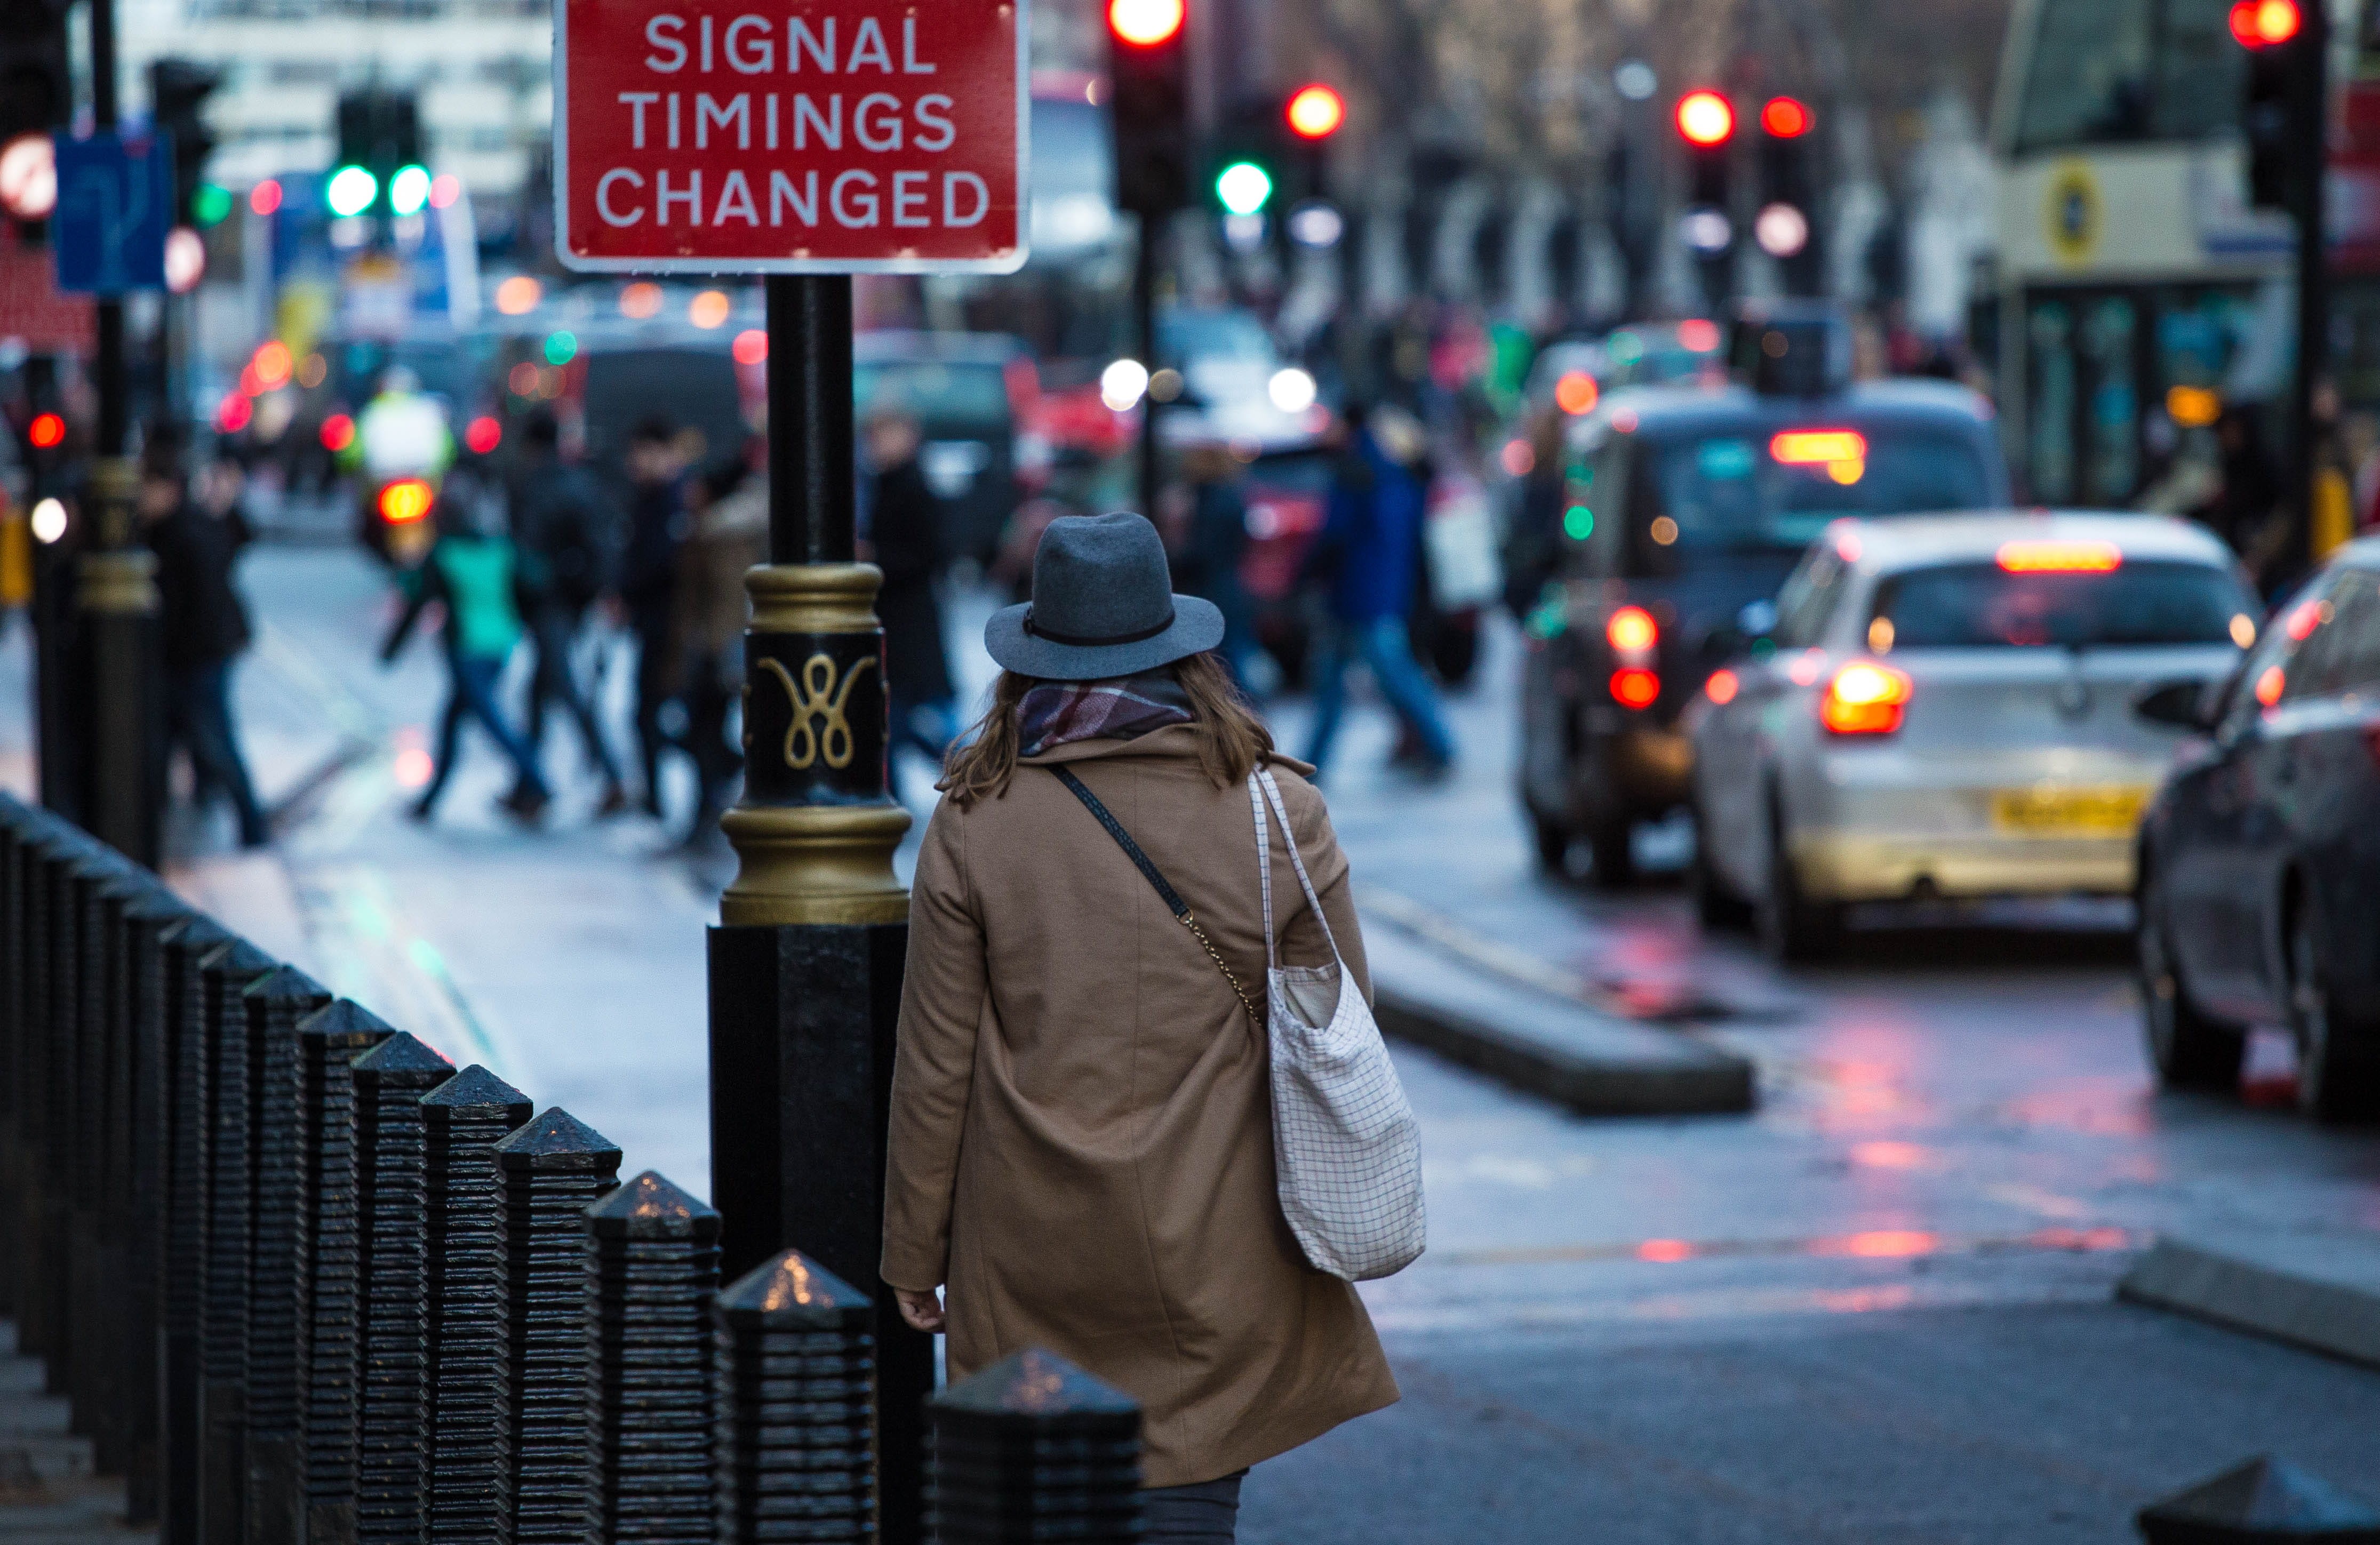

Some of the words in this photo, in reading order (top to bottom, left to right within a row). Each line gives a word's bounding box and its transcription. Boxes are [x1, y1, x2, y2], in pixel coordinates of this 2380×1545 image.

[644, 14, 936, 74] SIGNAL
[618, 92, 956, 151] TIMINGS
[595, 167, 991, 228] CHANGED
